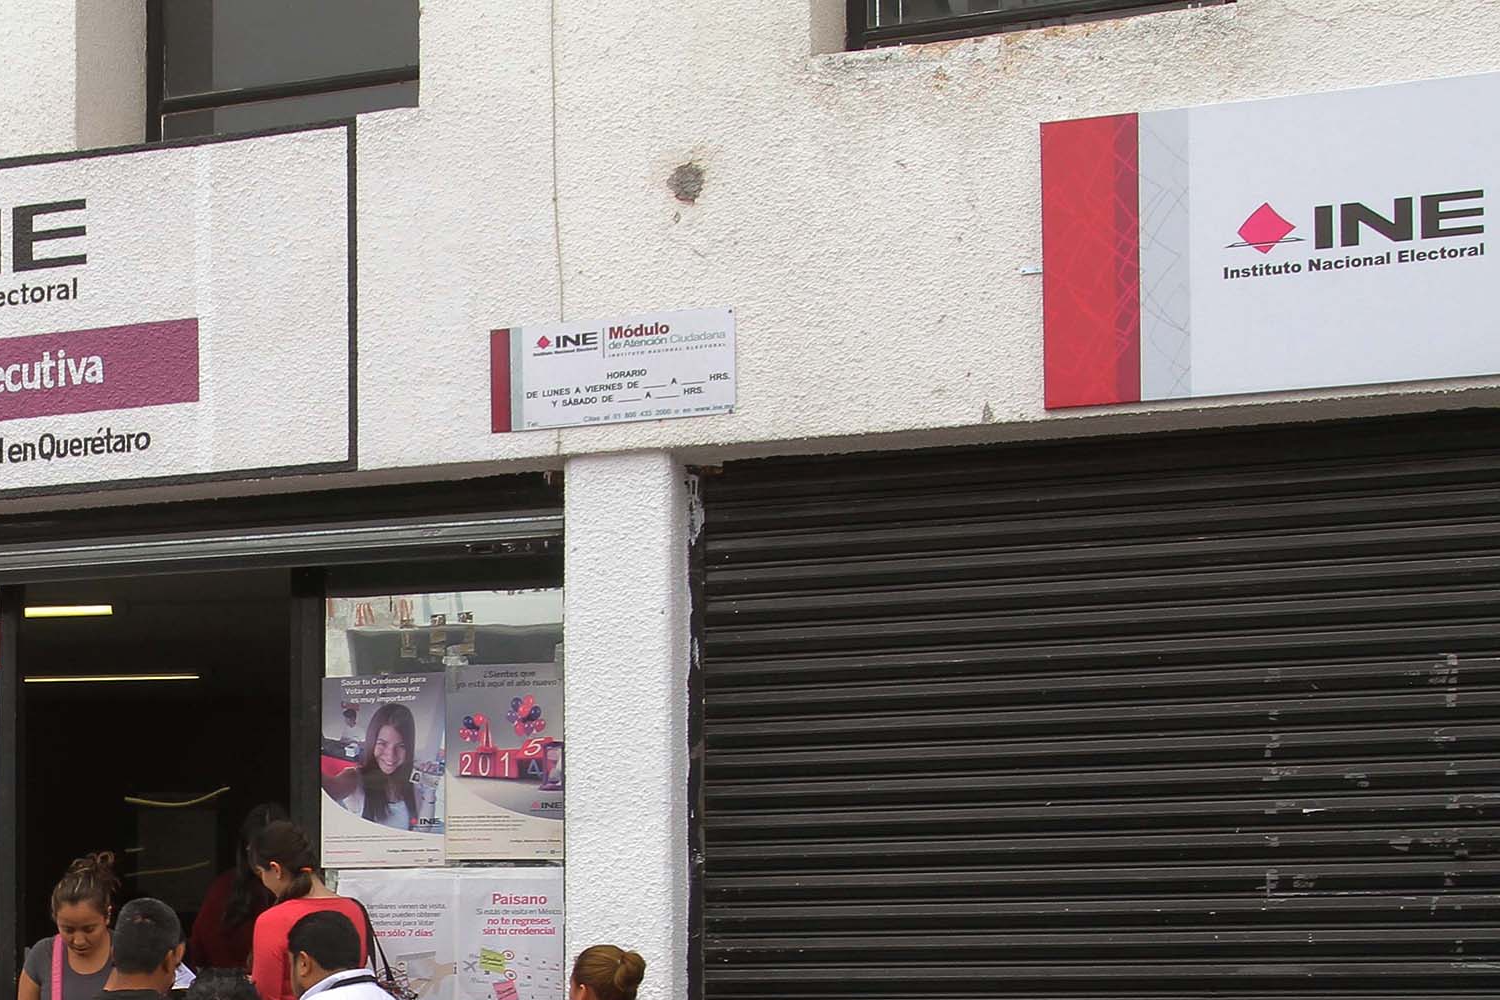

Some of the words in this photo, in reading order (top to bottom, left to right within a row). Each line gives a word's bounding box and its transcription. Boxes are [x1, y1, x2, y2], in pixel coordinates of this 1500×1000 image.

[1314, 189, 1485, 250] INE
[1223, 260, 1302, 280] Instituto
[1308, 251, 1391, 272] Nacional
[1397, 243, 1485, 264] Electoral
[609, 322, 670, 340] Módulo
[555, 332, 598, 348] INE
[608, 340, 621, 349] de
[623, 336, 667, 348] Atención
[670, 331, 726, 343] Ciudadana
[607, 369, 647, 379] HORARIO
[542, 388, 570, 398] LUNES
[585, 382, 623, 392] VIERNES
[627, 381, 640, 389] DE
[671, 377, 677, 385] A
[709, 373, 730, 381] HRS.
[562, 397, 597, 408] SÁBADO
[683, 387, 705, 395] HRS.
[8, 440, 37, 464] en
[38, 429, 152, 464] Querétaro
[371, 676, 409, 685] Credencial
[379, 686, 407, 695] primera
[492, 893, 548, 905] Paisano
[501, 917, 509, 925] te
[511, 918, 551, 926] regreses
[387, 928, 406, 937] sólo
[408, 929, 413, 937] 7
[482, 927, 496, 935] sin
[509, 927, 555, 935] credencial
